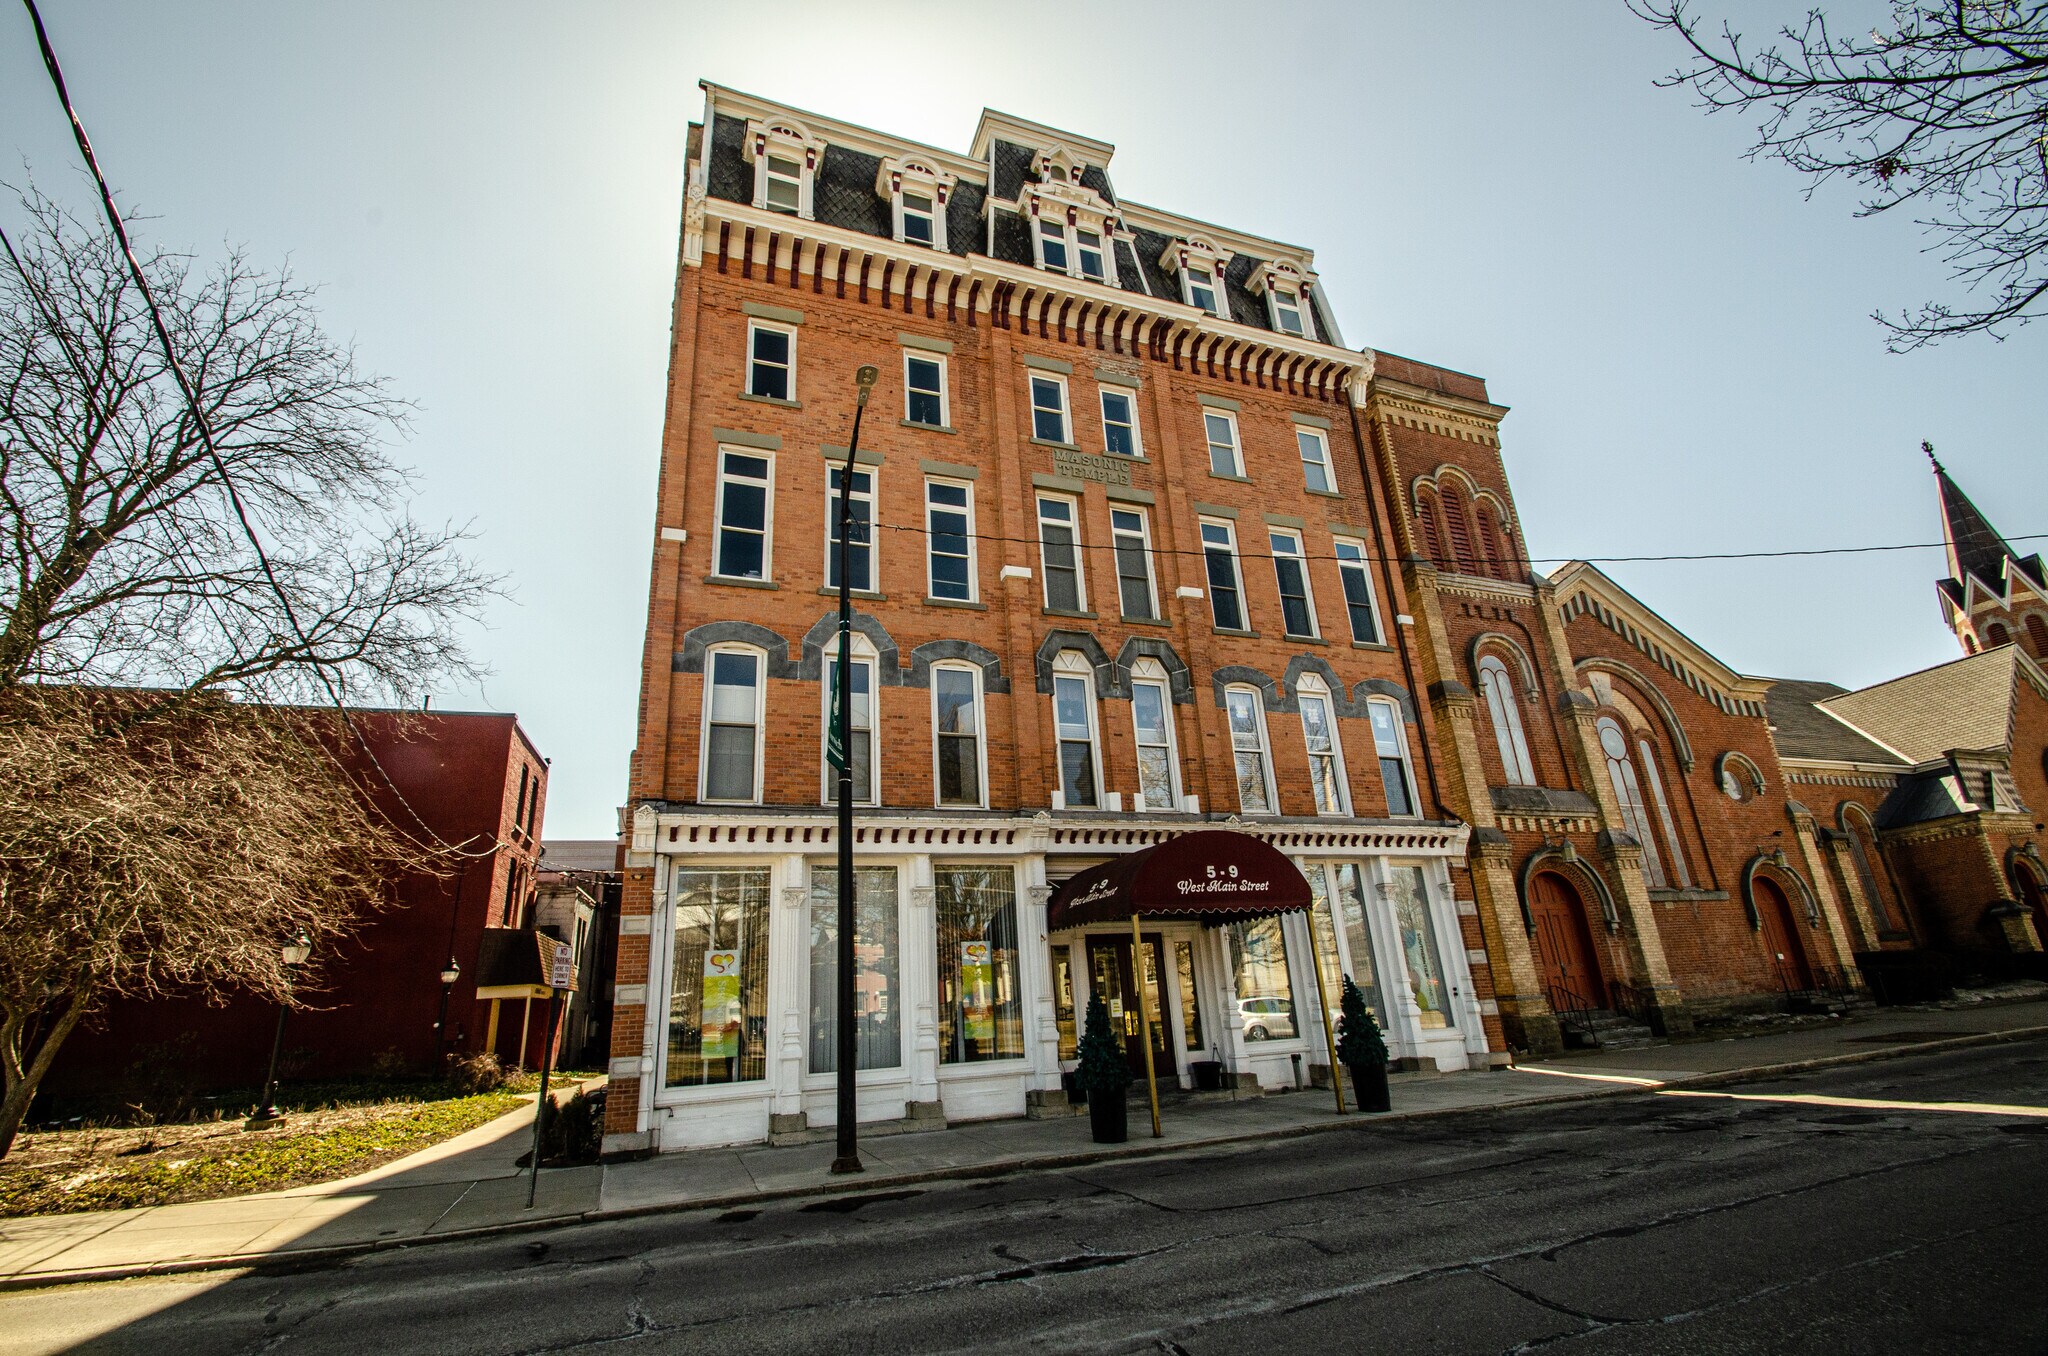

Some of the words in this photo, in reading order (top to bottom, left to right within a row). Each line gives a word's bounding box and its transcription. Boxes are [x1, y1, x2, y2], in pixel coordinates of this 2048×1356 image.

[1054, 449, 1129, 472] MASONIC
[1058, 464, 1129, 486] TEMPLE
[1177, 879, 1205, 894] West
[1206, 880, 1238, 892] Main
[1240, 880, 1269, 891] Street
[555, 957, 571, 965] PARKING
